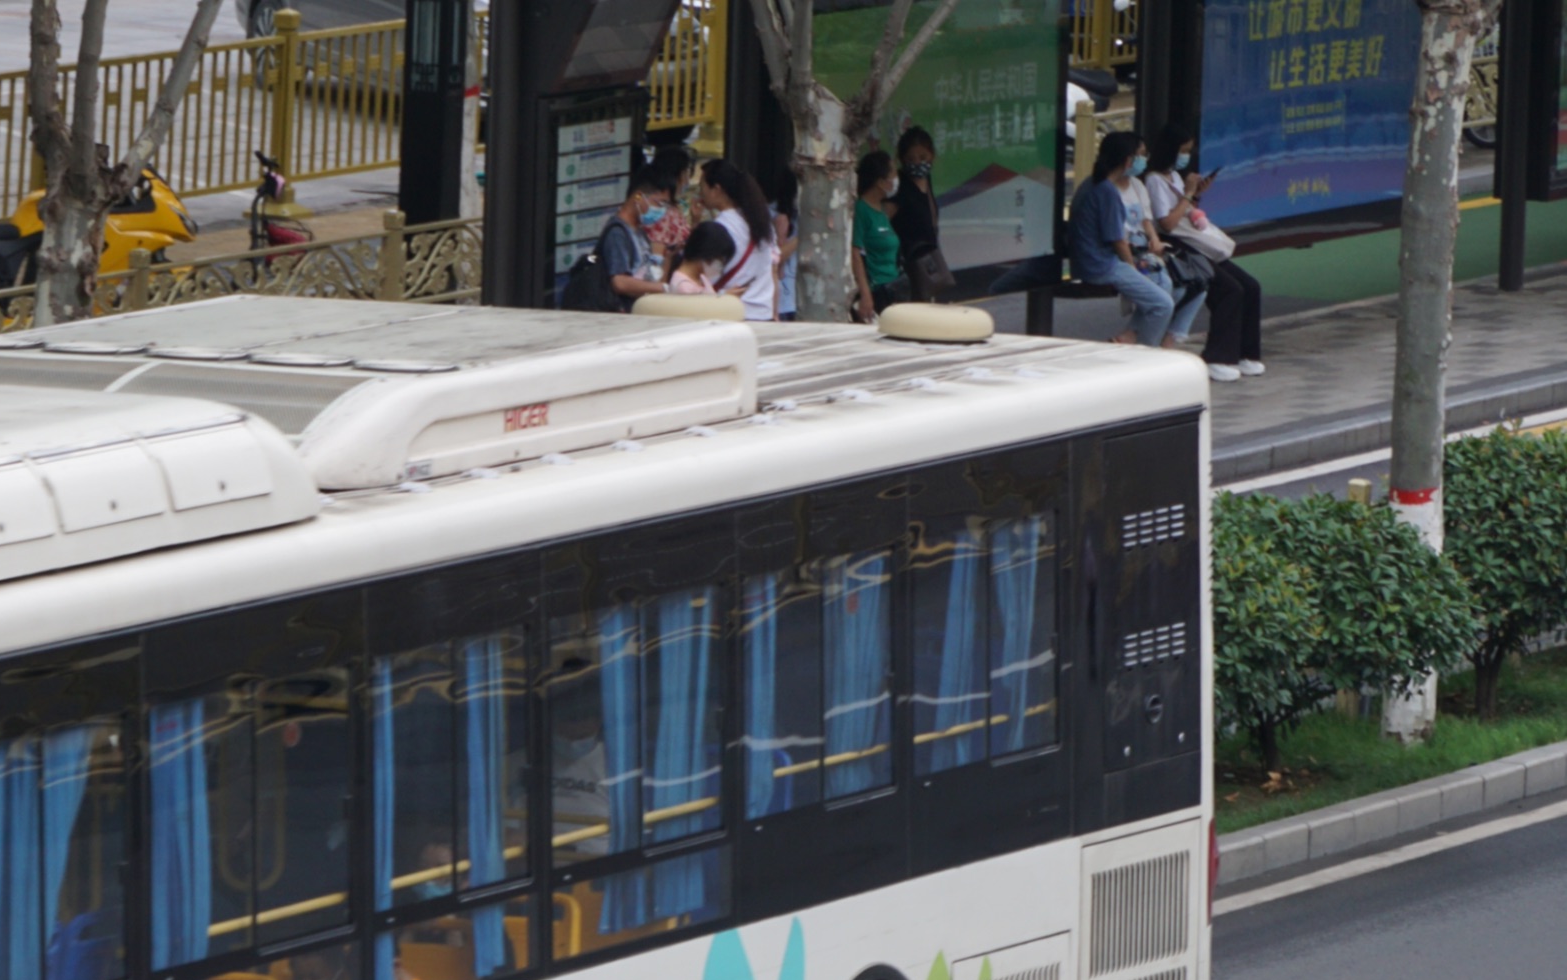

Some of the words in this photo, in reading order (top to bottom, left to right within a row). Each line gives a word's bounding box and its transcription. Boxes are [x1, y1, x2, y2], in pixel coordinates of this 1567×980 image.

[934, 62, 1039, 110] 中华人民共和国
[1268, 34, 1385, 90] 让生活更美好
